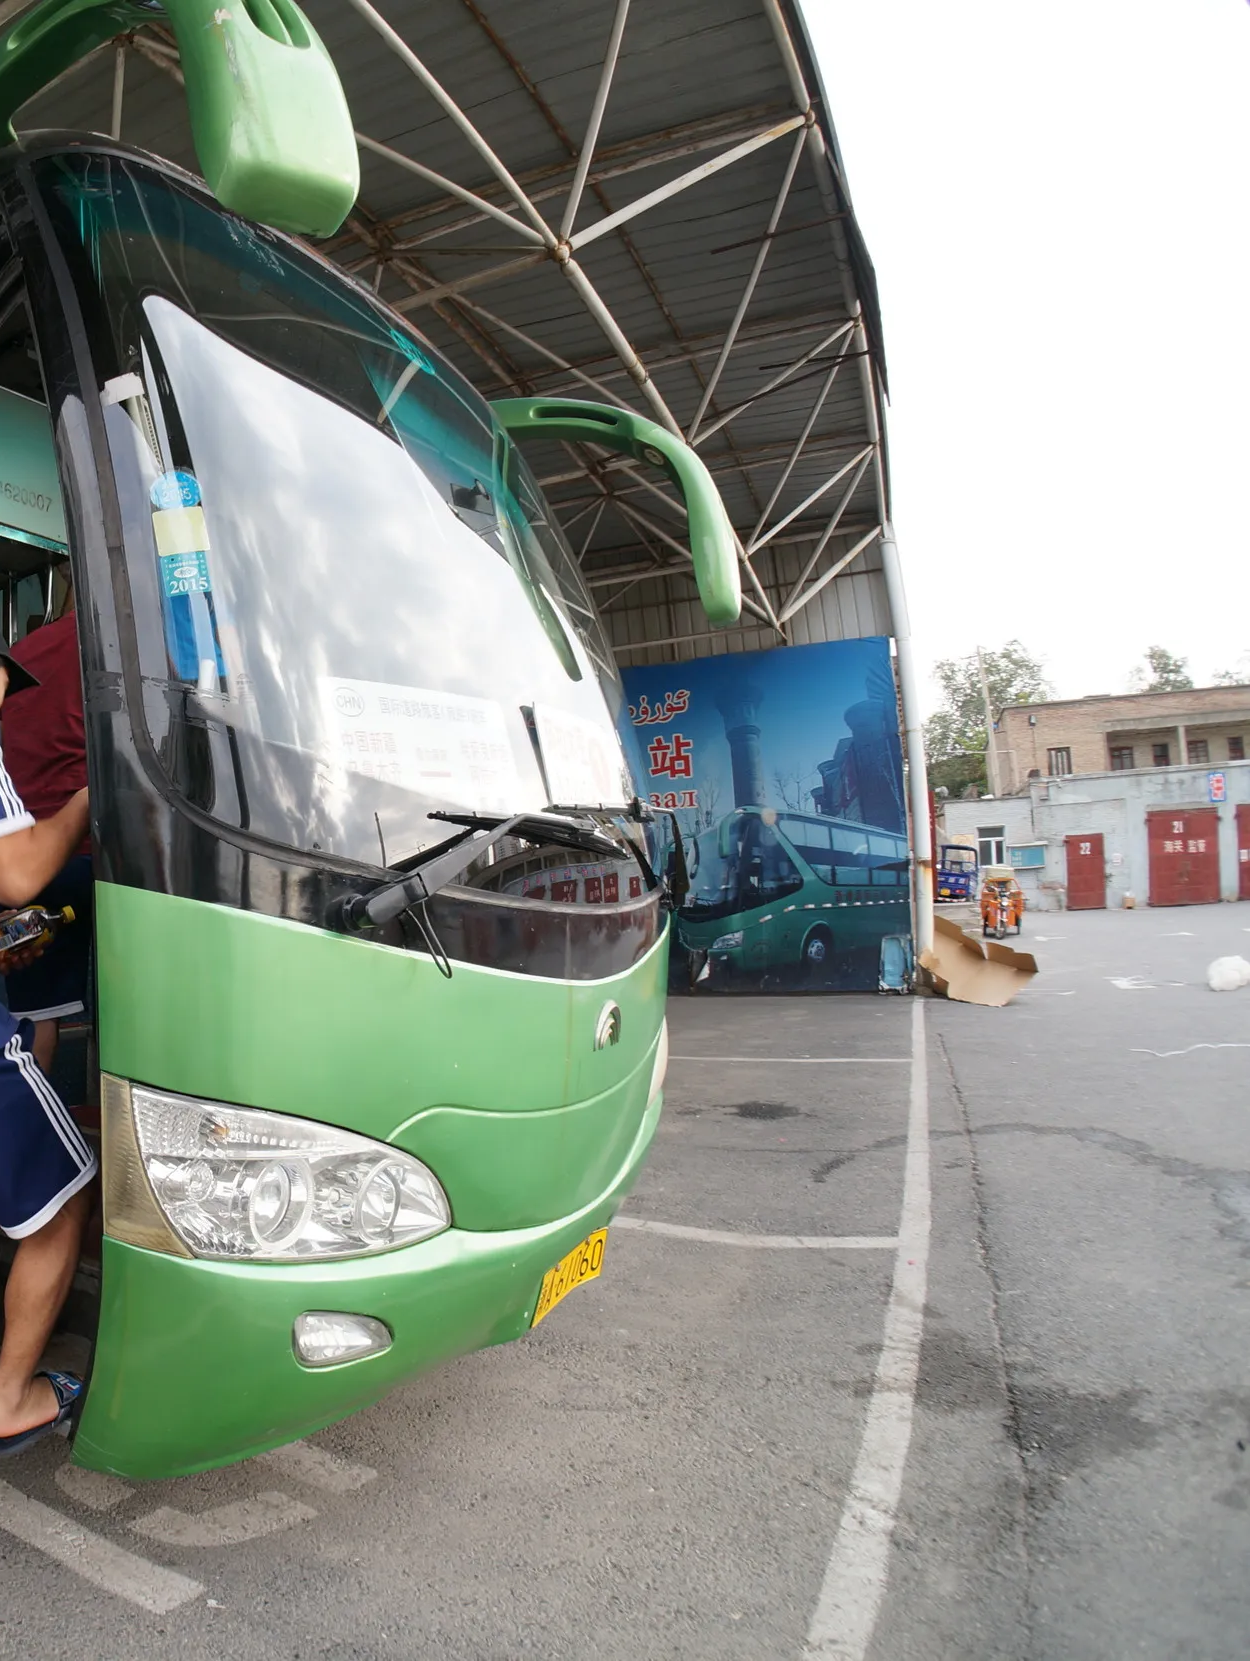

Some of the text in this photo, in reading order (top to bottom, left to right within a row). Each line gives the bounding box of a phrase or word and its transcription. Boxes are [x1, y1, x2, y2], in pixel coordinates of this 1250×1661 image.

[170, 577, 209, 595] 2015
[335, 694, 362, 711] CHN
[341, 731, 398, 755] 中国新疆
[647, 734, 693, 779] 站
[1079, 842, 1091, 855] 22
